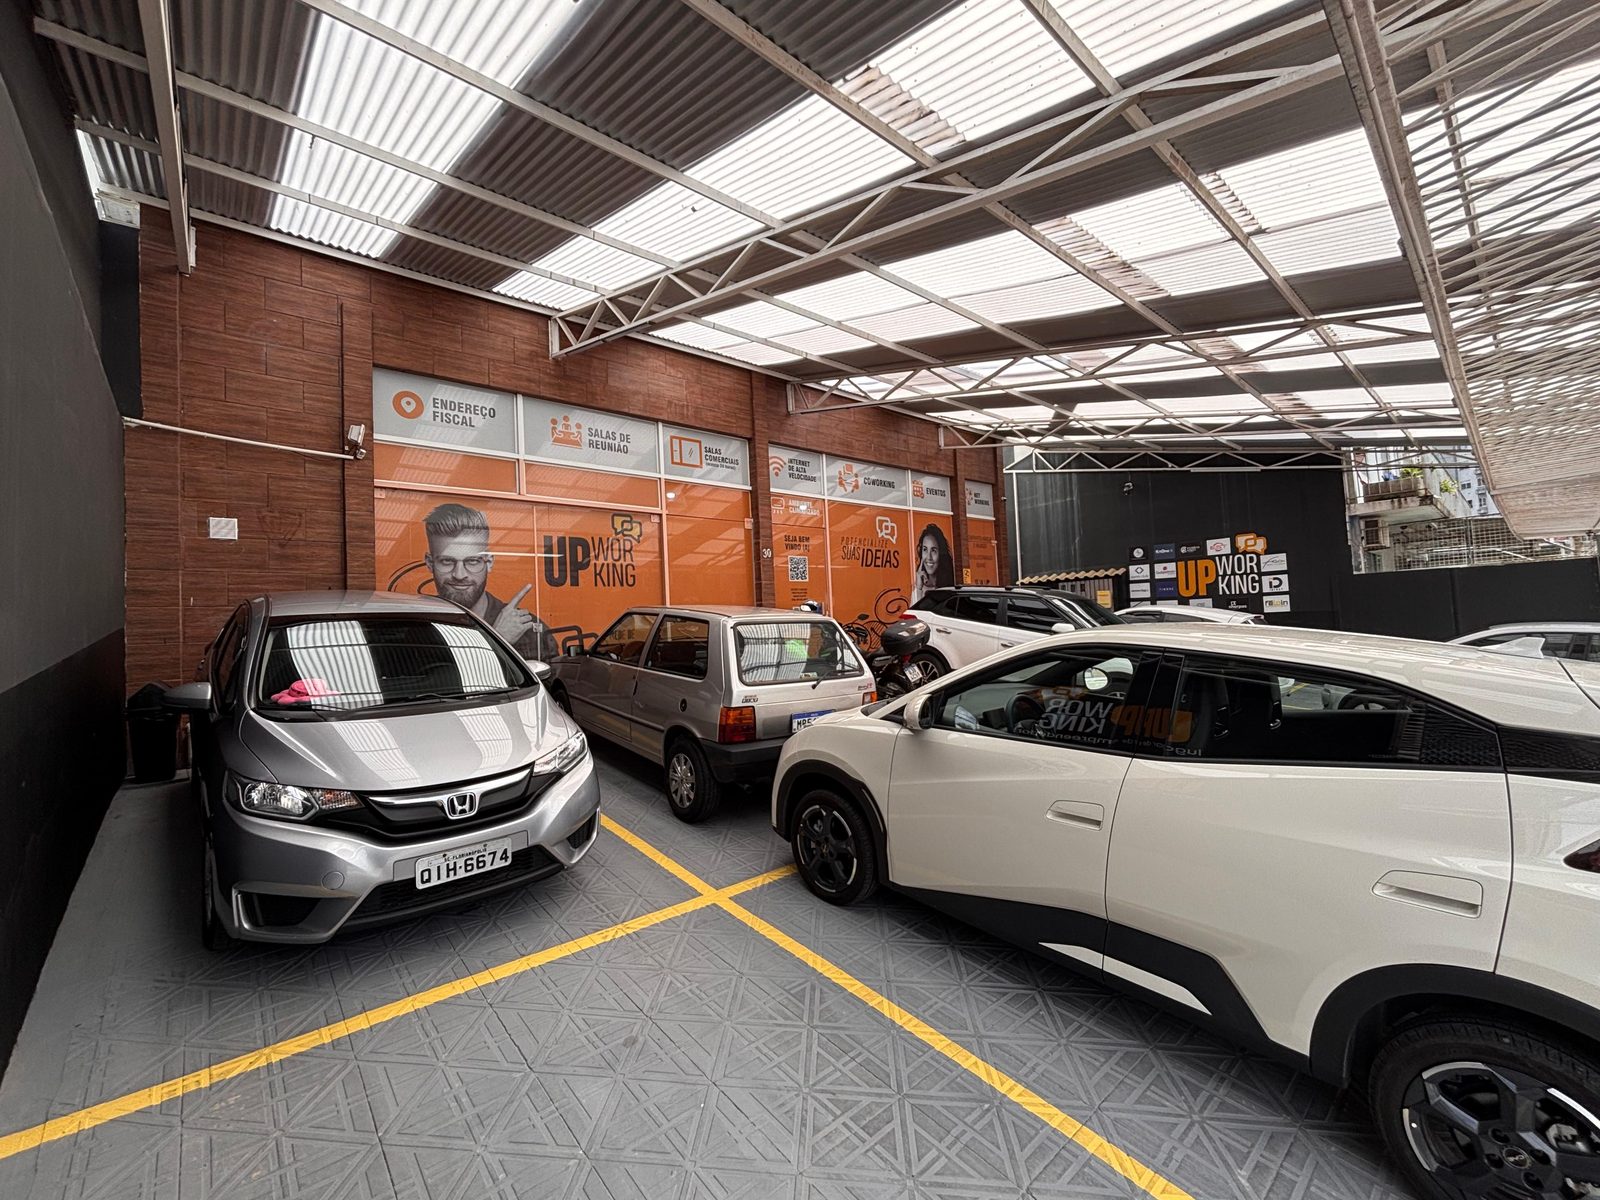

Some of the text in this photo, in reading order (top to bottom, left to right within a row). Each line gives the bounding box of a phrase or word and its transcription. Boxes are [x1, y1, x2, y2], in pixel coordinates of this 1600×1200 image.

[432, 397, 496, 420] ENDEREÇO
[432, 411, 475, 428] FISCAL
[588, 427, 631, 444] SALAS DE
[704, 446, 722, 455] SALAS
[704, 453, 739, 466] COMERCIAIS
[787, 458, 810, 467] INTERNET
[788, 472, 817, 482] VELOCIDADE
[863, 476, 895, 489] COWORKING
[926, 487, 946, 498] EVENTOS
[784, 534, 810, 543] SEJA BEM
[840, 536, 888, 549] POTENCIALIZE
[762, 548, 772, 559] 30
[784, 543, 801, 551] VINDO
[543, 535, 634, 588] UP WOR
[841, 545, 900, 569] SUAS IDEIAS
[593, 563, 636, 588] KING
[1177, 553, 1258, 597] UP WOR
[1218, 573, 1260, 596] KING
